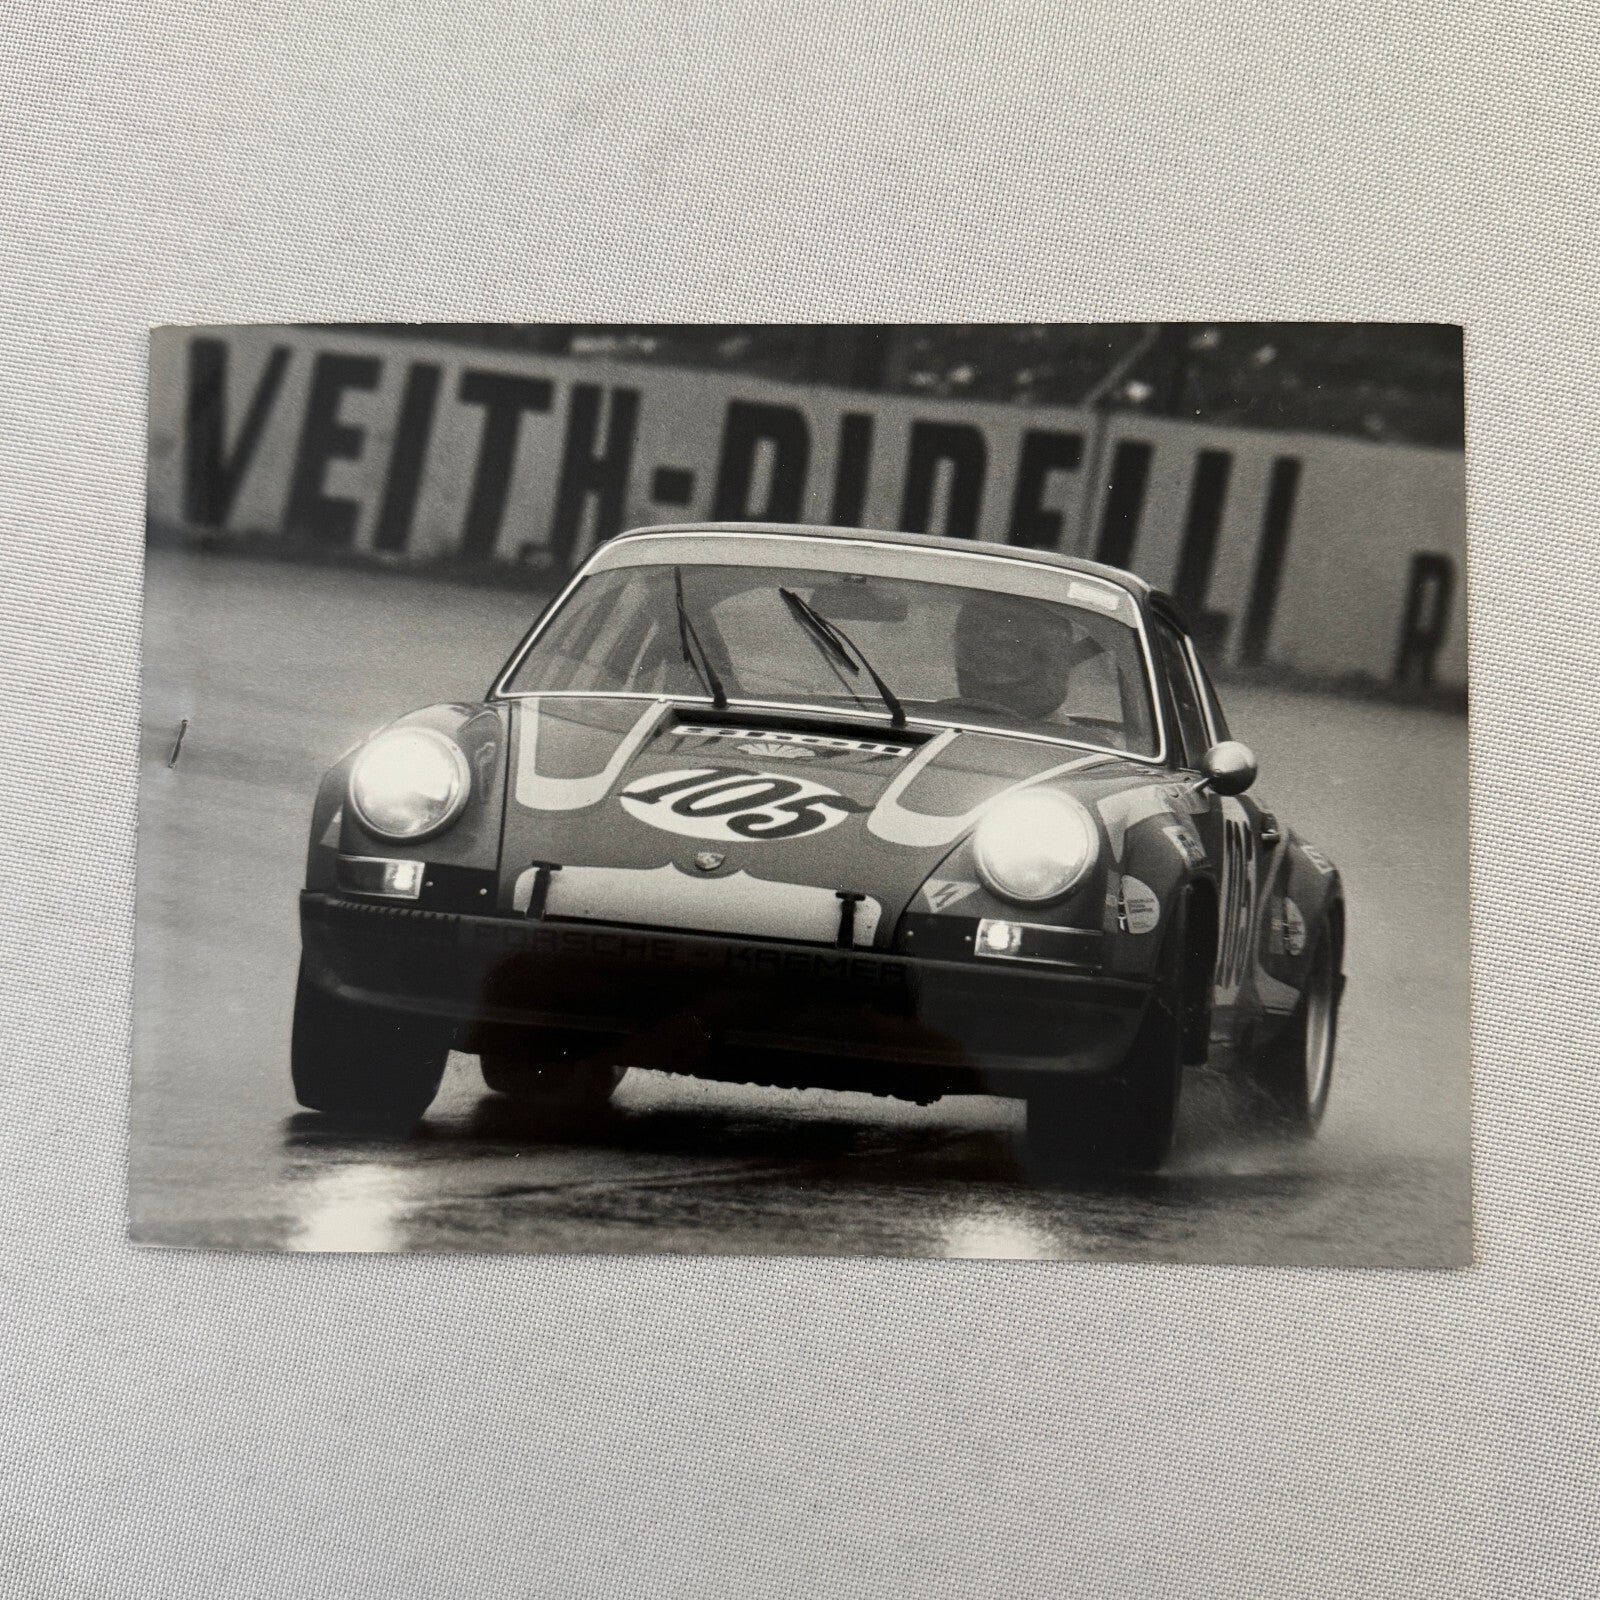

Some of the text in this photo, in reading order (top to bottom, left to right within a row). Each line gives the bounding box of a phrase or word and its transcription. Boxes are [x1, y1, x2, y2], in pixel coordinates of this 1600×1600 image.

[618, 766, 876, 839] 105
[474, 922, 674, 961] PORSCHE
[724, 945, 905, 982] KREMER
